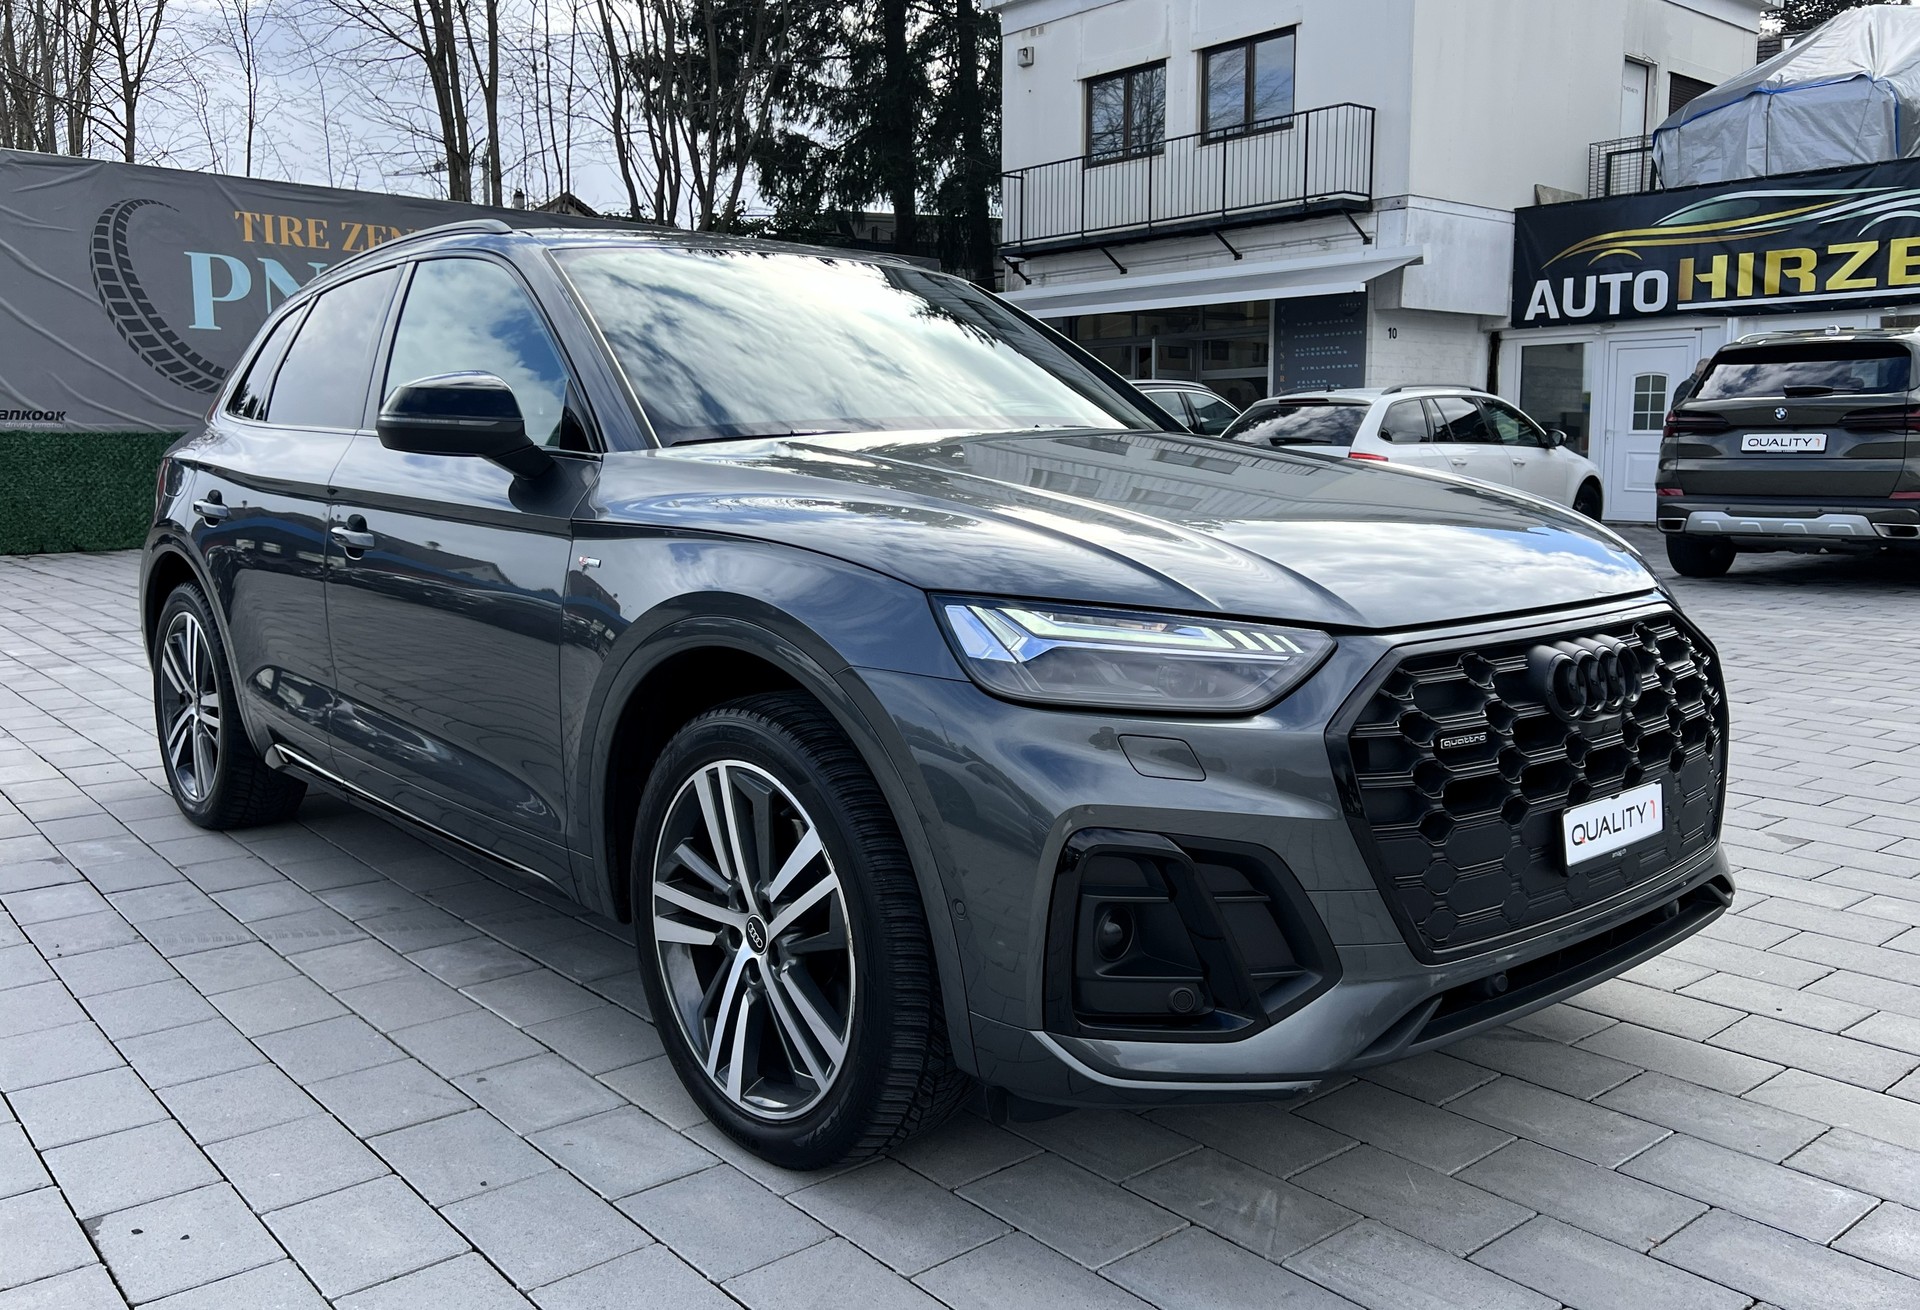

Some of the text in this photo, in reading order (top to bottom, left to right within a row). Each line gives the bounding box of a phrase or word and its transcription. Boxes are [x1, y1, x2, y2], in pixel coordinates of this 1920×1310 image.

[234, 210, 330, 249] TIRE
[1524, 237, 1920, 320] AUTO HIRZE
[1388, 327, 1398, 339] 10
[1748, 438, 1812, 447] QUALITY
[1443, 734, 1487, 748] quattro
[1571, 801, 1647, 847] QUALITY
